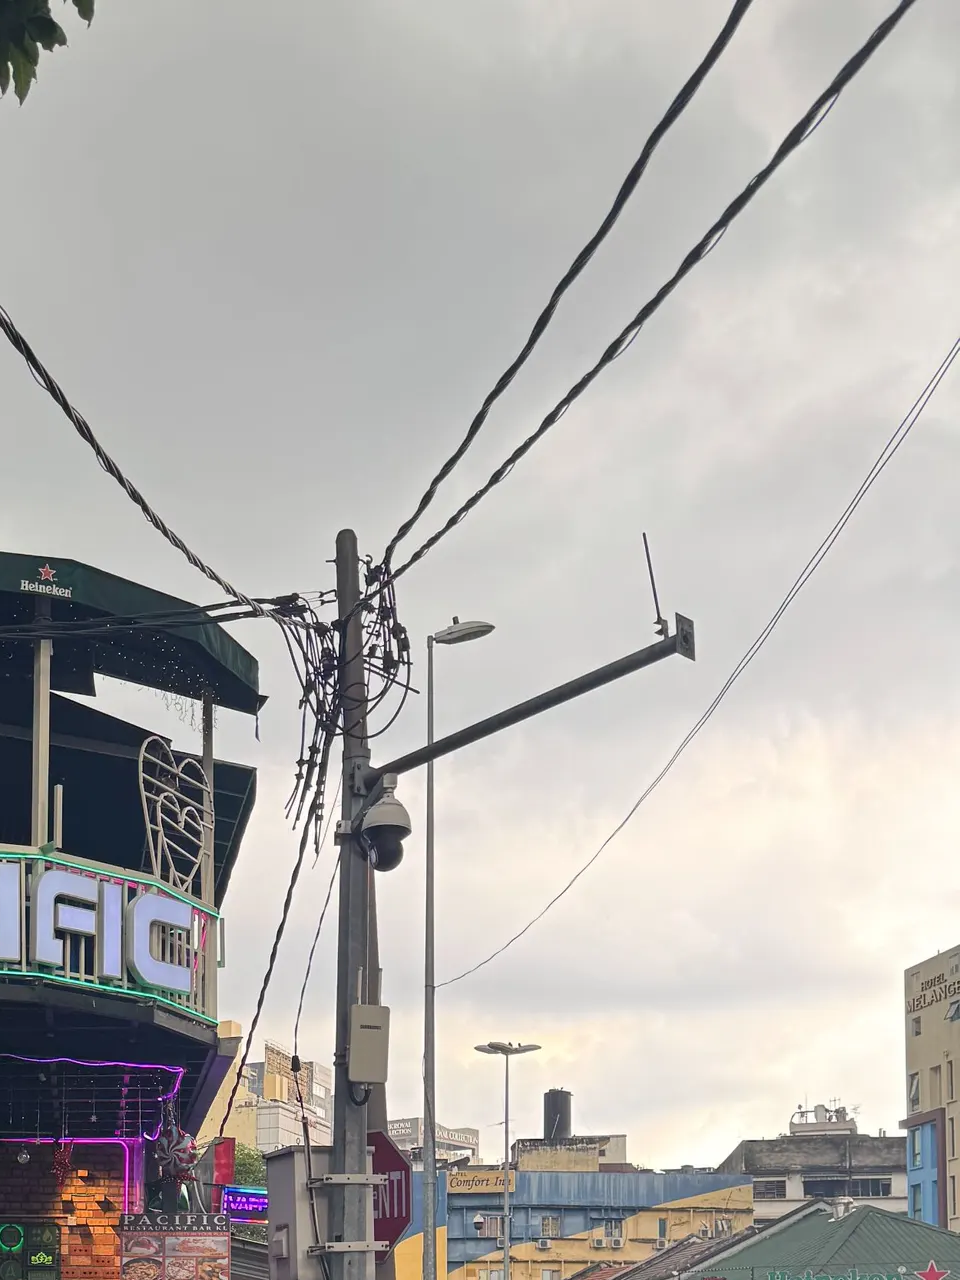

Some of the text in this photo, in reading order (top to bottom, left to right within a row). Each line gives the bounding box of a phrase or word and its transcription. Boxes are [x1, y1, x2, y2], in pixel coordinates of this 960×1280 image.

[20, 580, 72, 598] Heineken
[921, 973, 947, 992] HOTEL
[388, 1128, 412, 1136] LECTION
[449, 1131, 479, 1145] COLLECTION
[450, 1176, 490, 1190] Comfort
[124, 1215, 226, 1225] PACIFIC
